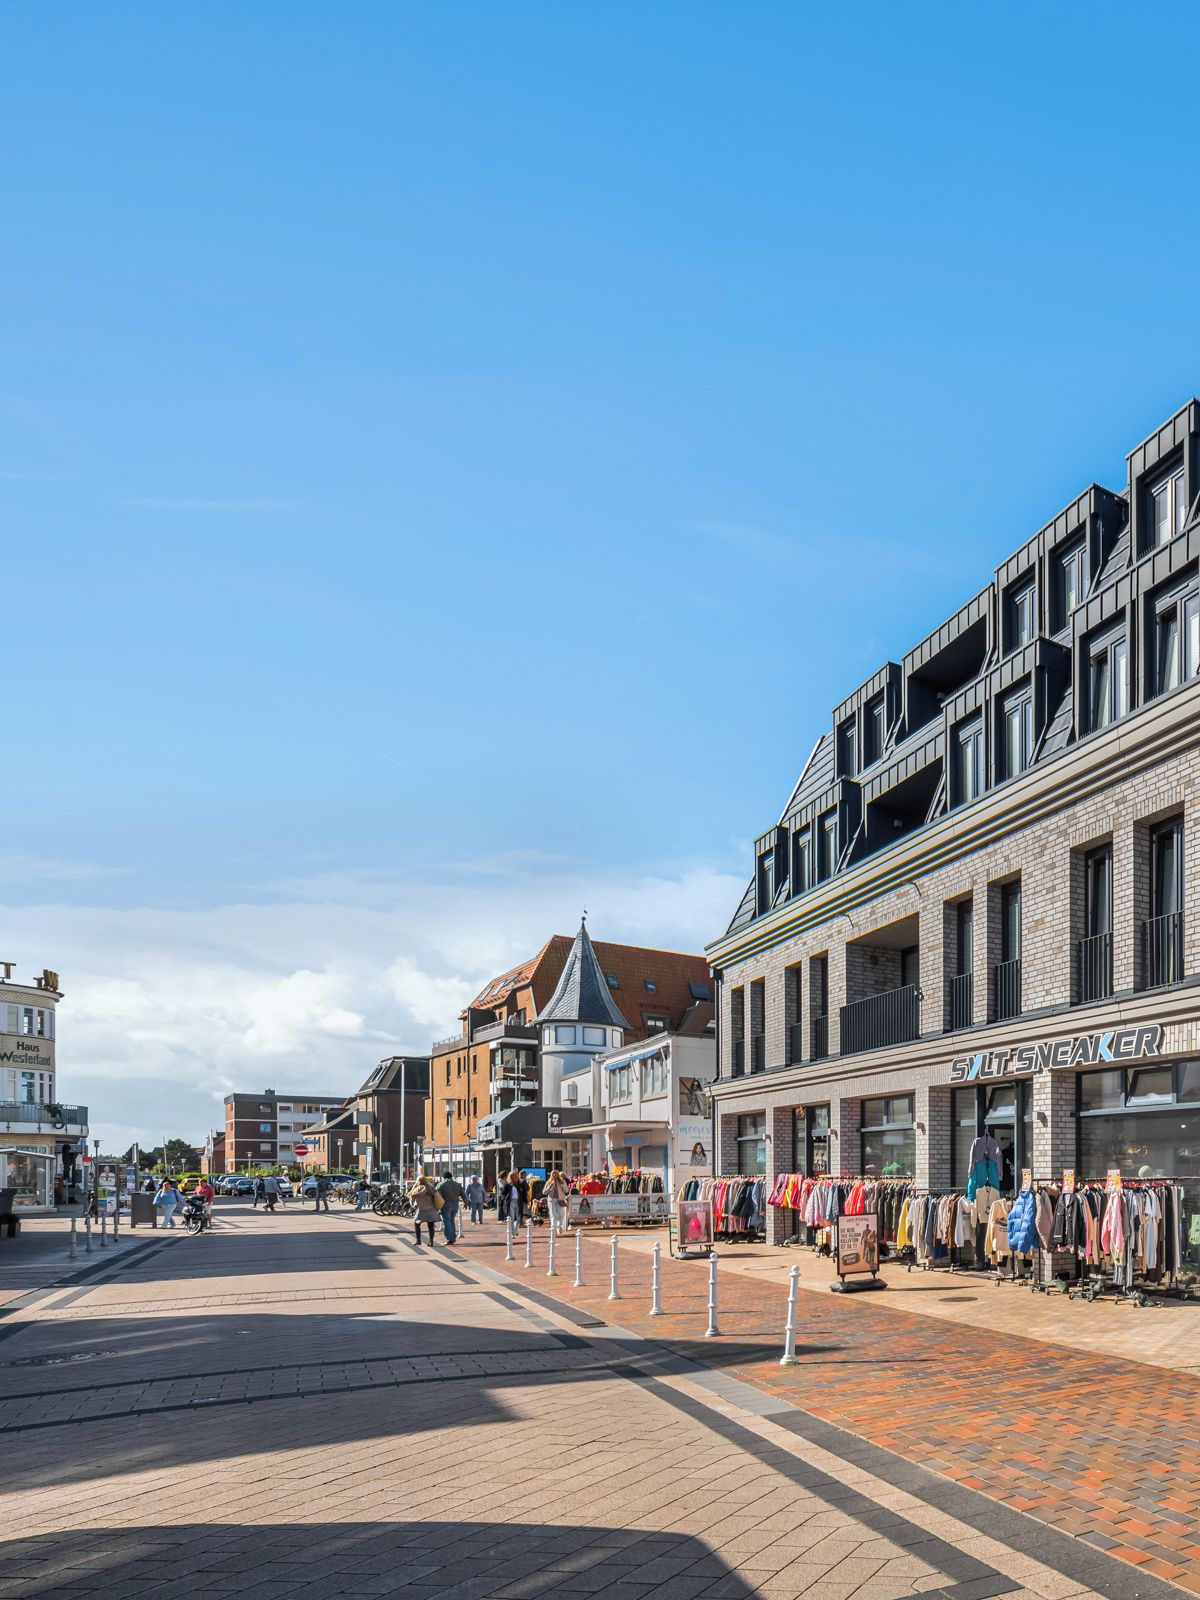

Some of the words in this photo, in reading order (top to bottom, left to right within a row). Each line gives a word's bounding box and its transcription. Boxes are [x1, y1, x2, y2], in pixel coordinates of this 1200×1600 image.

[17, 1041, 40, 1052] Haus
[949, 1049, 1010, 1083] SYLT
[1014, 1024, 1162, 1074] SNEAKER
[0, 1051, 50, 1066] Westerland
